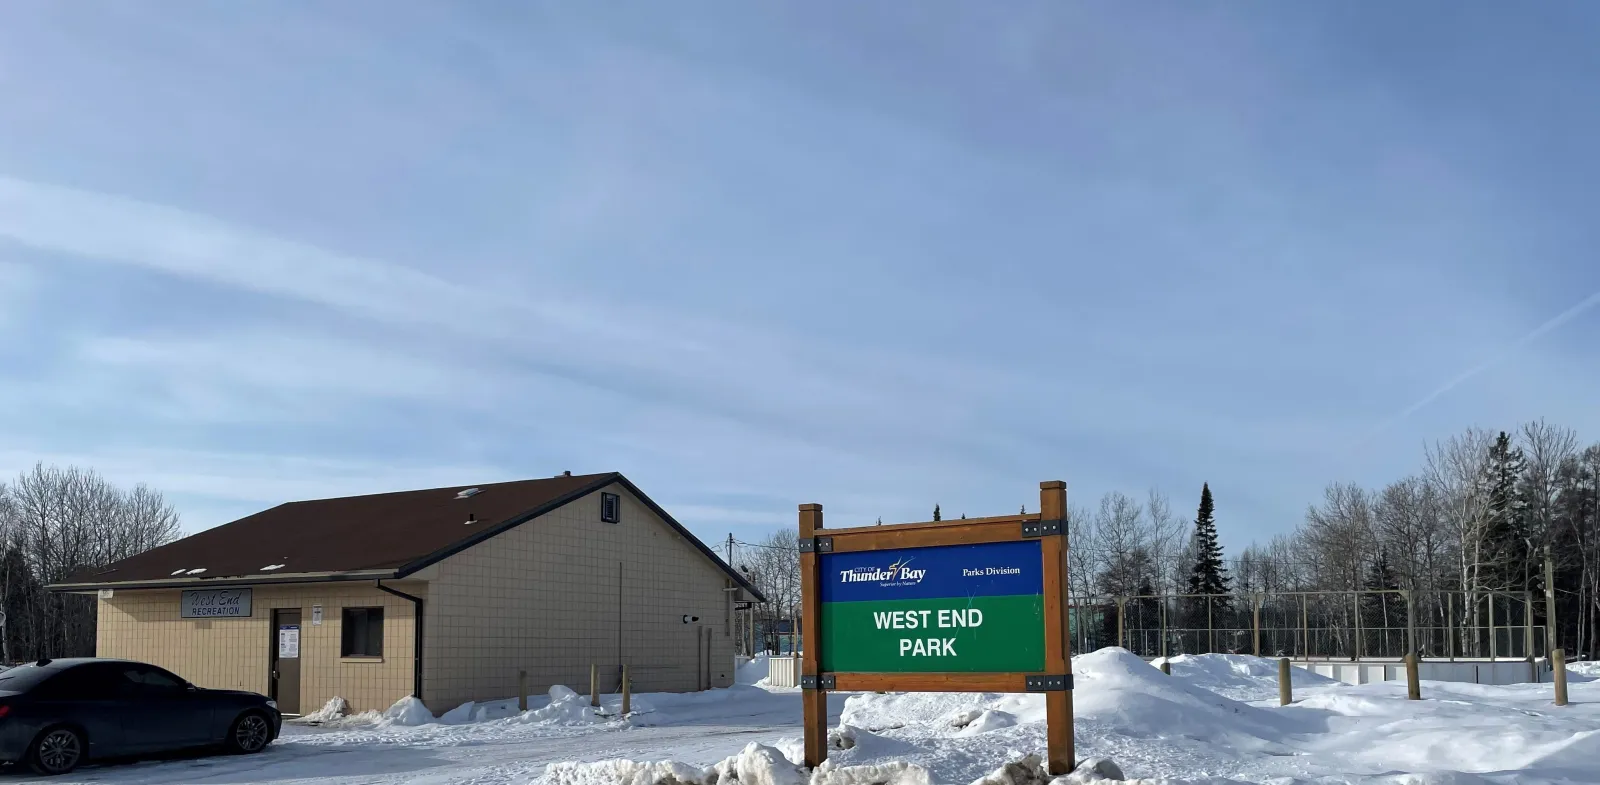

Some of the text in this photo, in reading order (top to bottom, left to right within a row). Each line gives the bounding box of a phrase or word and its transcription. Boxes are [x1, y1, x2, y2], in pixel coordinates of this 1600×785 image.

[840, 567, 926, 583] Thunder Bay
[962, 566, 1021, 577] Parks Division
[190, 590, 242, 606] West End
[191, 607, 240, 616] RECREATION
[873, 608, 983, 630] WEST END
[899, 637, 958, 657] PARK
